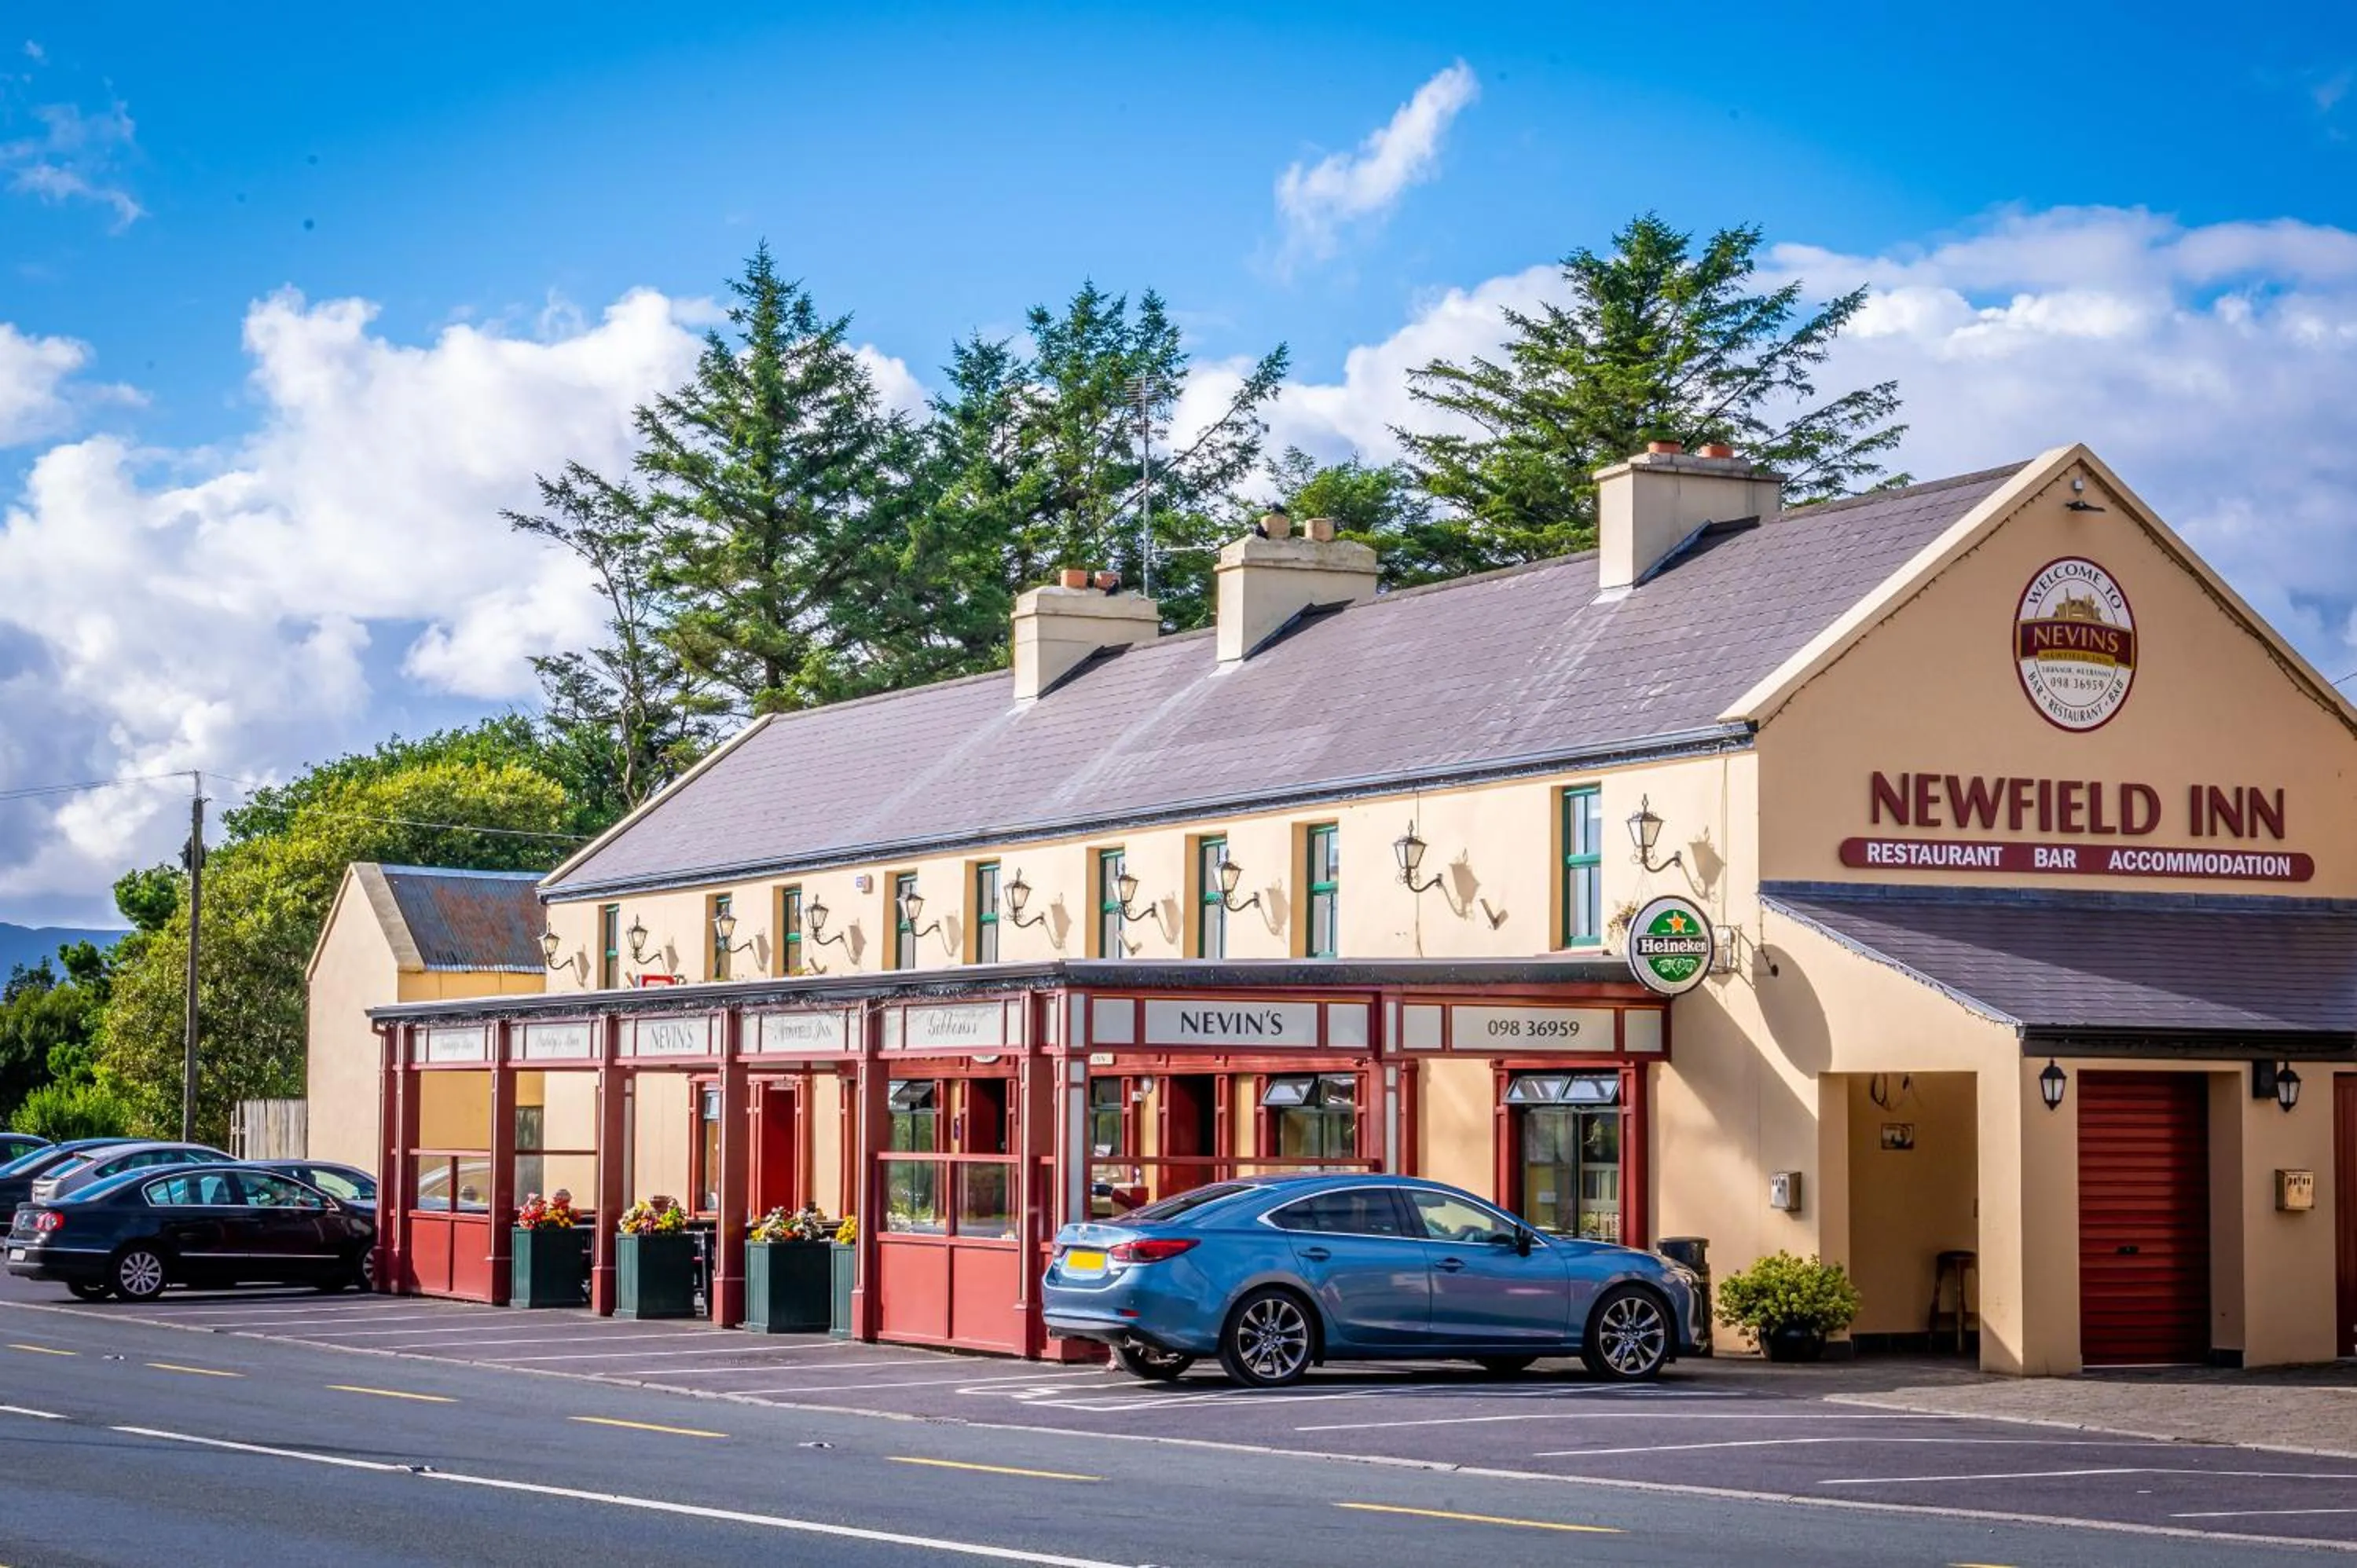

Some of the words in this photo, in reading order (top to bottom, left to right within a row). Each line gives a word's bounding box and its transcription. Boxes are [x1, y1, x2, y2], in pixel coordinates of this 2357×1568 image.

[2029, 563, 2102, 604] WELCOME
[2105, 584, 2122, 609] TO
[2034, 625, 2119, 653] NEVINS
[2051, 677, 2069, 689] 098
[2073, 678, 2105, 691] 36959
[2048, 698, 2103, 722] RESTAURANT
[1871, 770, 2161, 835] NEWFIELD
[2190, 783, 2285, 839] INN
[1867, 842, 2003, 866] RESTAURANT
[2034, 847, 2077, 869] BAR
[2109, 849, 2291, 877] ACCOMMODATION
[1640, 939, 1707, 953] Heineken
[1181, 1009, 1283, 1036] NEVIN'S
[1488, 1020, 1520, 1036] 098
[1527, 1020, 1580, 1037] 36959
